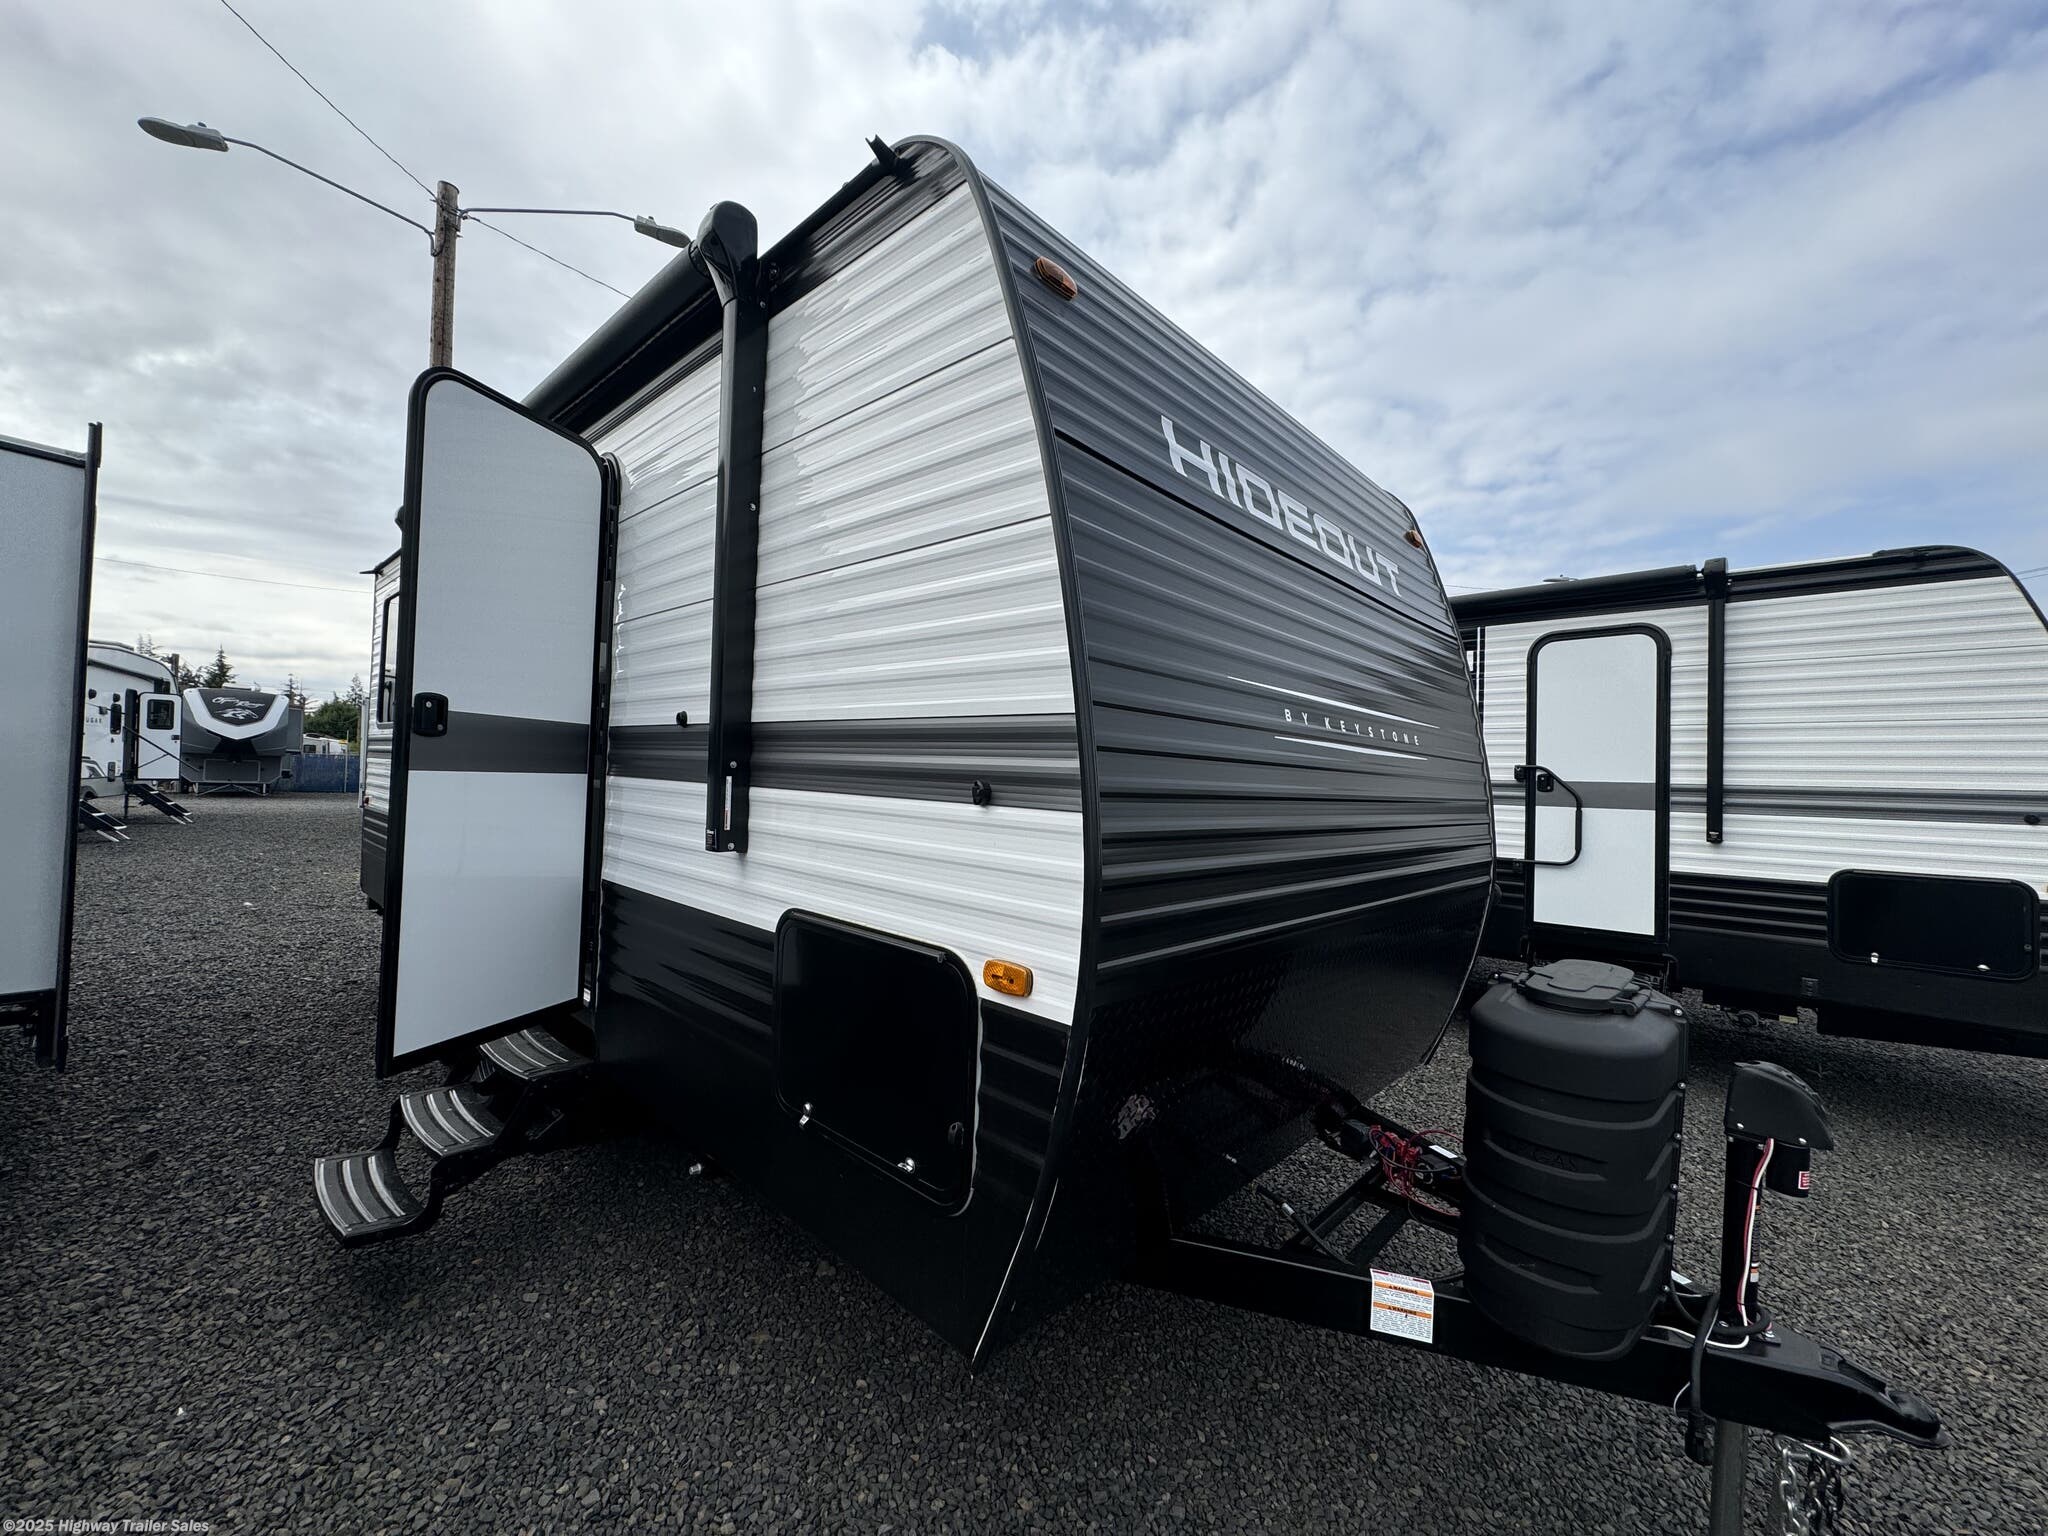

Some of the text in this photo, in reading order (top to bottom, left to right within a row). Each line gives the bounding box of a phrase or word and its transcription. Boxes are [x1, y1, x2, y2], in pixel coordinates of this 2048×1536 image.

[1161, 415, 1402, 598] HIDEOUT
[1284, 708, 1420, 746] BY KEYSTONE
